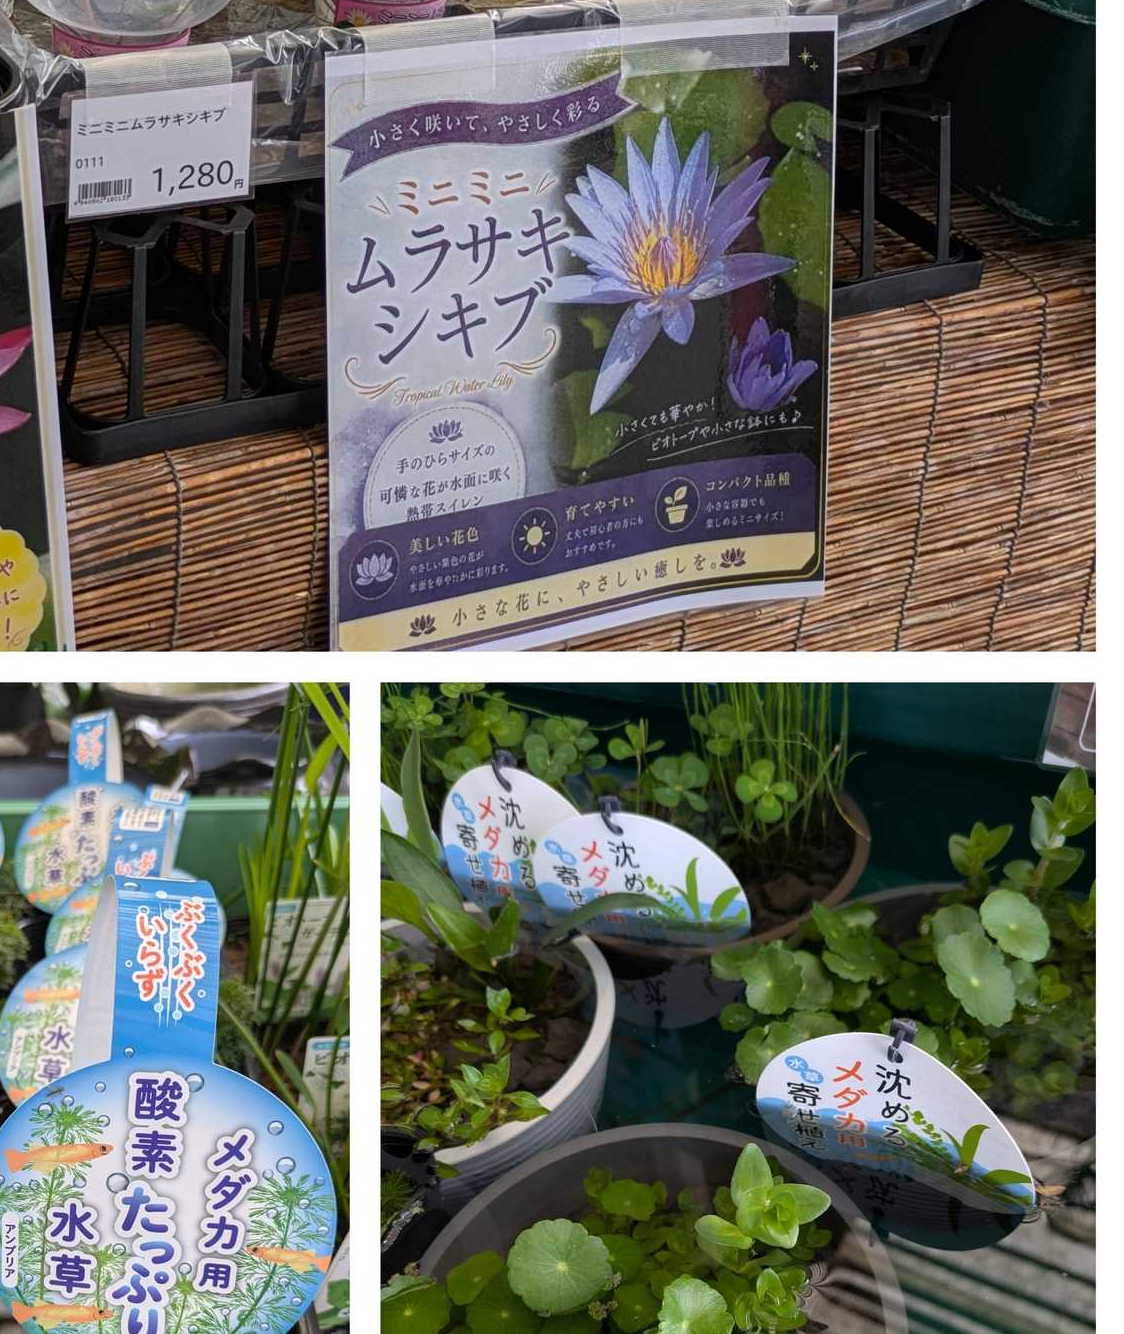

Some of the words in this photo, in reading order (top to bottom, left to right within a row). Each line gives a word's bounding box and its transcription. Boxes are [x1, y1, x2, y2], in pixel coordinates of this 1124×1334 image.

[77, 107, 227, 136] ミニミニムラサキシキブ
[368, 94, 601, 150] 小さく咲いて、やさしく彩る
[76, 156, 105, 169] 0111
[396, 171, 530, 215] ミニミニ
[346, 208, 571, 296] ムラサキ
[377, 276, 553, 366] シキブ
[392, 381, 444, 408] Tropical
[446, 376, 485, 399] Water
[487, 371, 516, 396] Lily
[613, 395, 718, 439] 小さくても華やか!
[395, 443, 496, 473] 手のひらサイズの
[378, 466, 513, 507] 可憐な花が水面に咲く
[704, 471, 791, 494] コンパクト品種
[564, 493, 636, 523] 育てやすい
[704, 496, 766, 514] 小さな容器でも
[704, 510, 785, 531] 楽しめるミニサイズ!
[408, 527, 480, 556] 美しい花色
[563, 538, 619, 561] おすすめです。
[451, 550, 718, 629] 小さな花に、やさしい癒しを。
[499, 797, 537, 889] 沈める
[135, 912, 168, 1002] いらず
[174, 898, 207, 1011] ぶくぶく
[832, 1060, 869, 1148] メダカ用
[876, 1063, 913, 1148] 沈める
[199, 1133, 254, 1291] メダカ用
[4, 1223, 16, 1278] アンブリア
[50, 1204, 98, 1294] 水草
